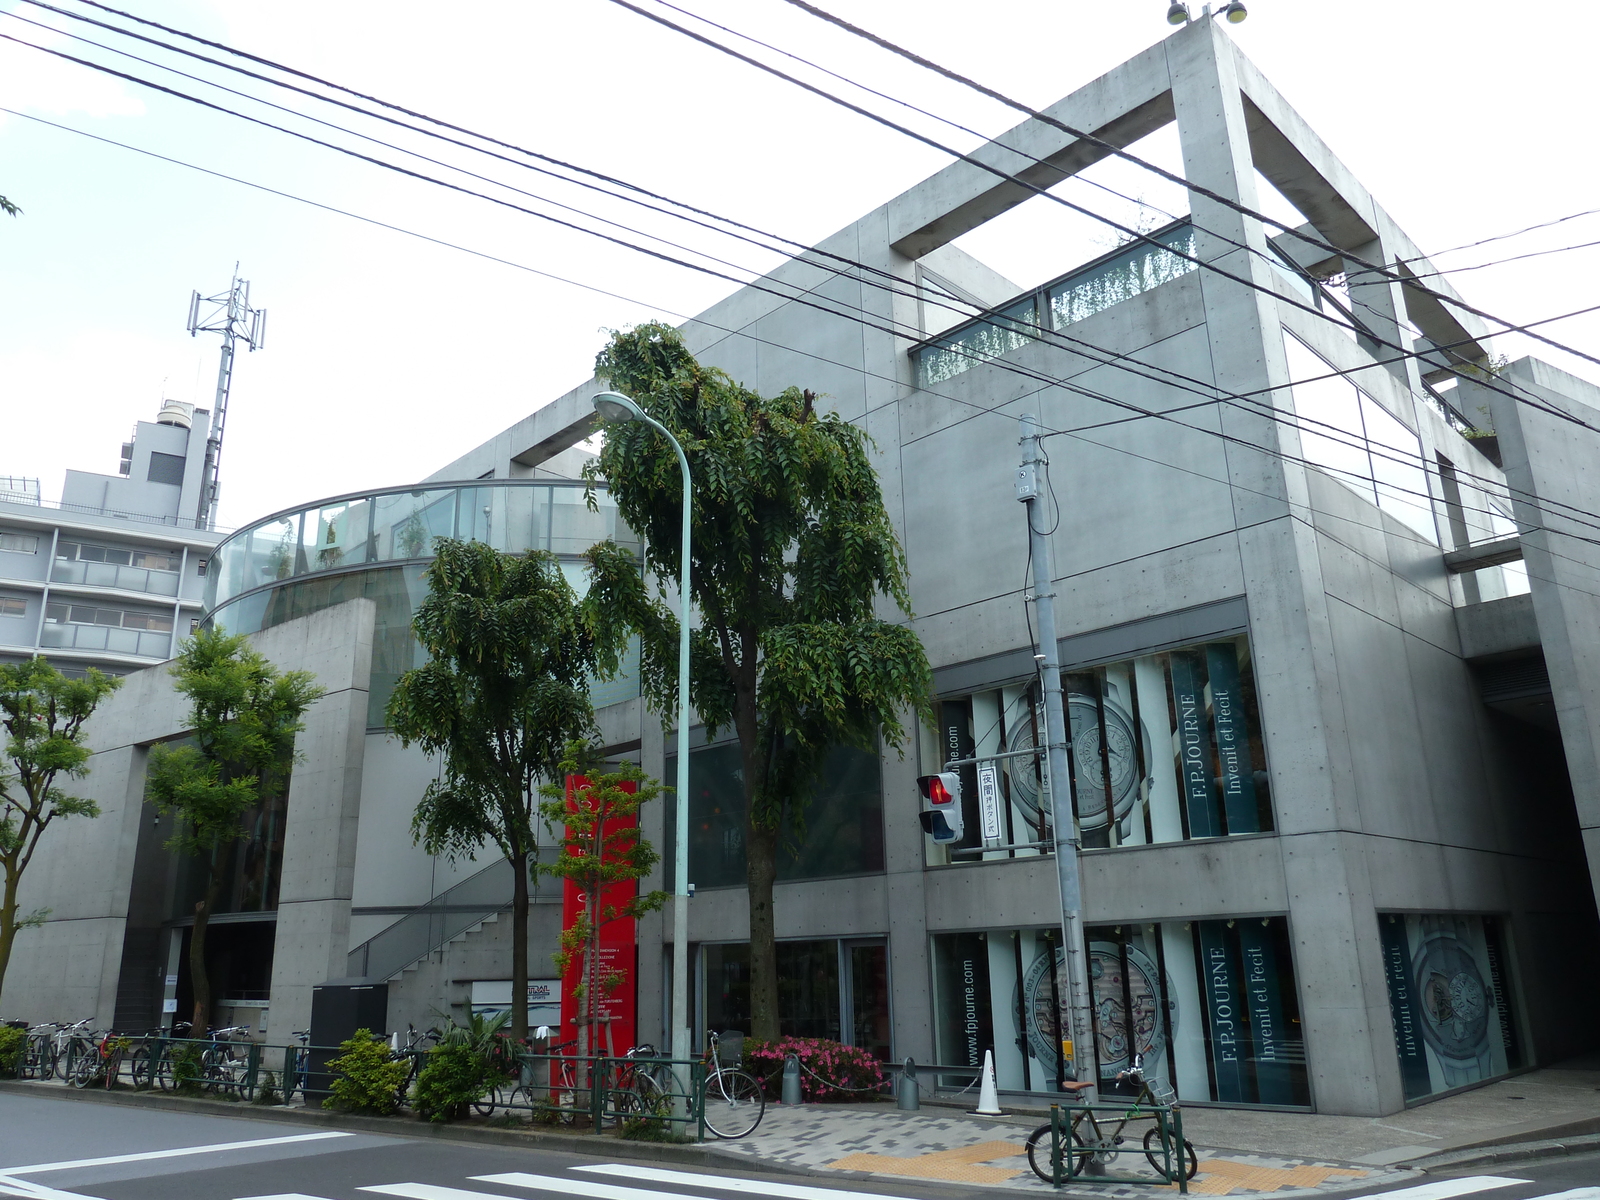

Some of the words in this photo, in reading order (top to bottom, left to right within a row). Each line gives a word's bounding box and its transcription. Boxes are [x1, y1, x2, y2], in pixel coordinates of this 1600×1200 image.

[1215, 690, 1233, 723] Fecit
[1180, 694, 1207, 799] F.P.JOURNE
[1220, 727, 1235, 741] et
[1222, 745, 1242, 795] Invenit
[1247, 946, 1266, 983] Fecit
[963, 960, 979, 1066] www.fpjourne.com
[1210, 947, 1238, 1063] F.P.JOURNE
[1253, 987, 1268, 1002] et
[1255, 1006, 1276, 1062] Invenit
